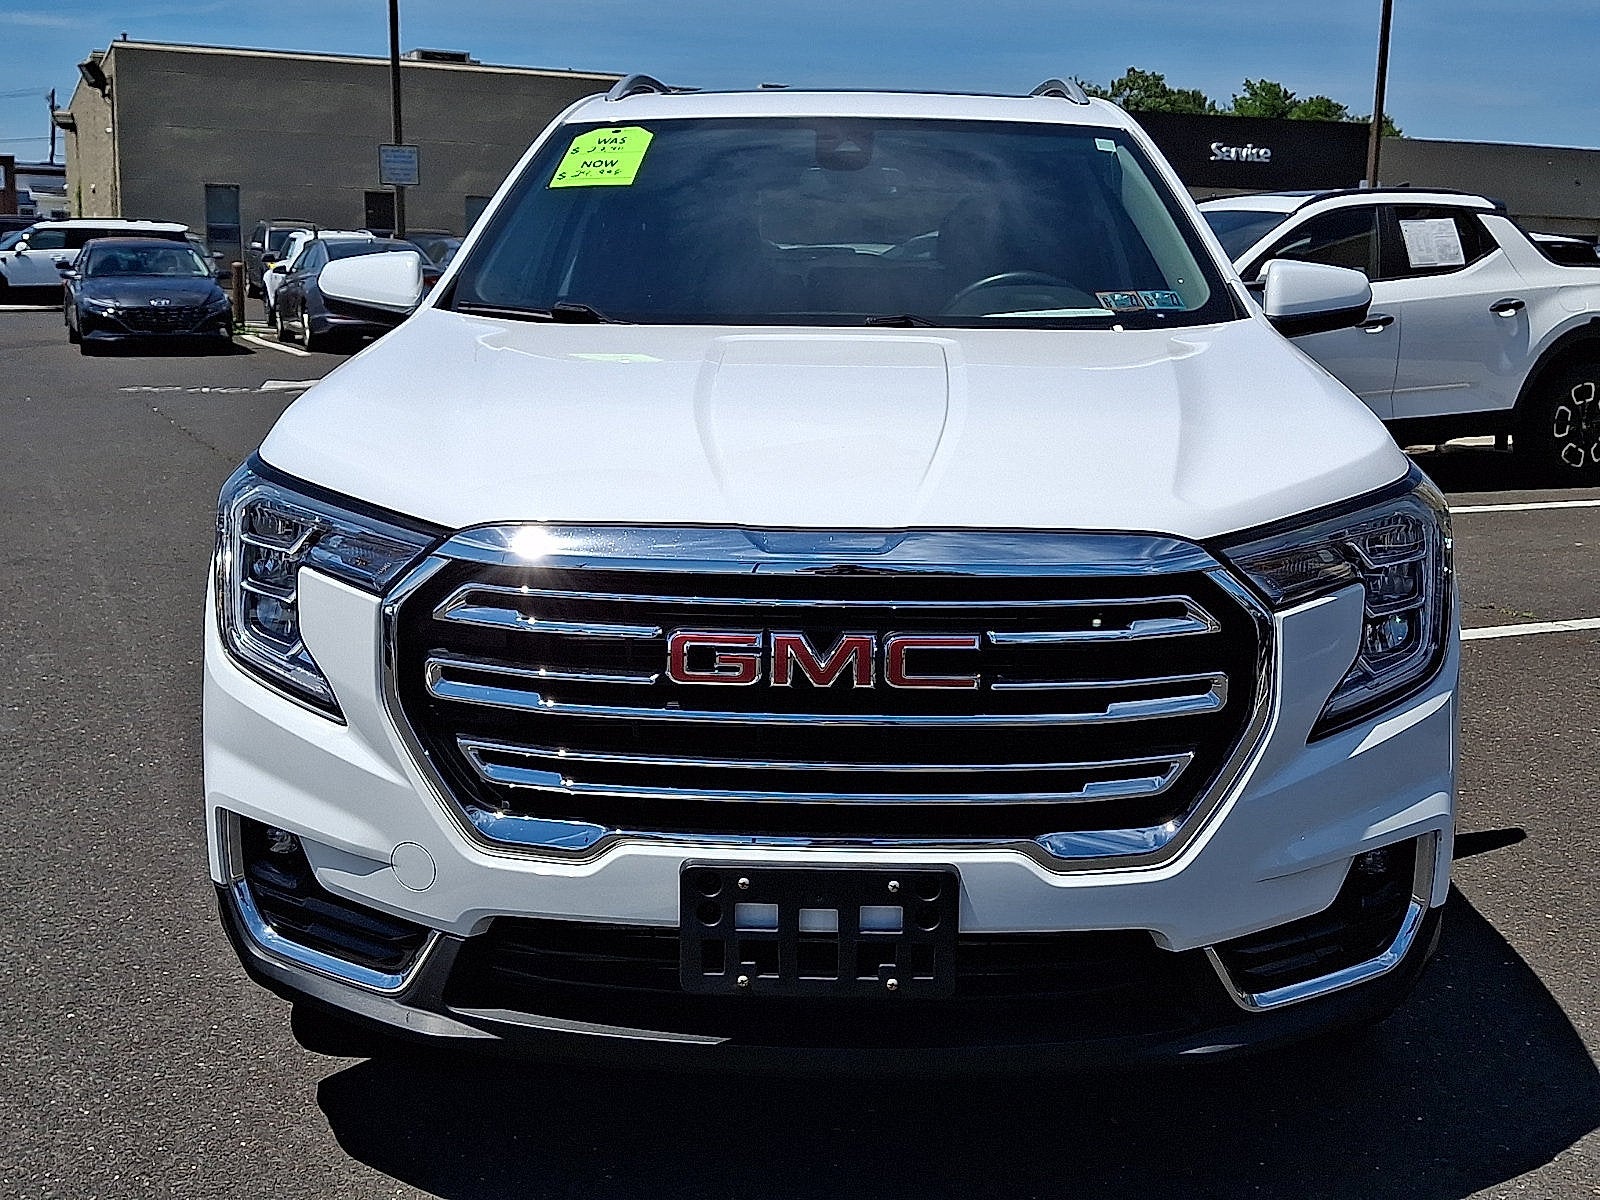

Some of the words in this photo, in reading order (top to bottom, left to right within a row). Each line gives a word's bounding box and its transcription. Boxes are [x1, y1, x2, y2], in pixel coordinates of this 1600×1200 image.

[597, 136, 628, 145] WAS
[1209, 142, 1272, 162] Service
[580, 159, 619, 169] NOW
[665, 627, 982, 691] GMC
